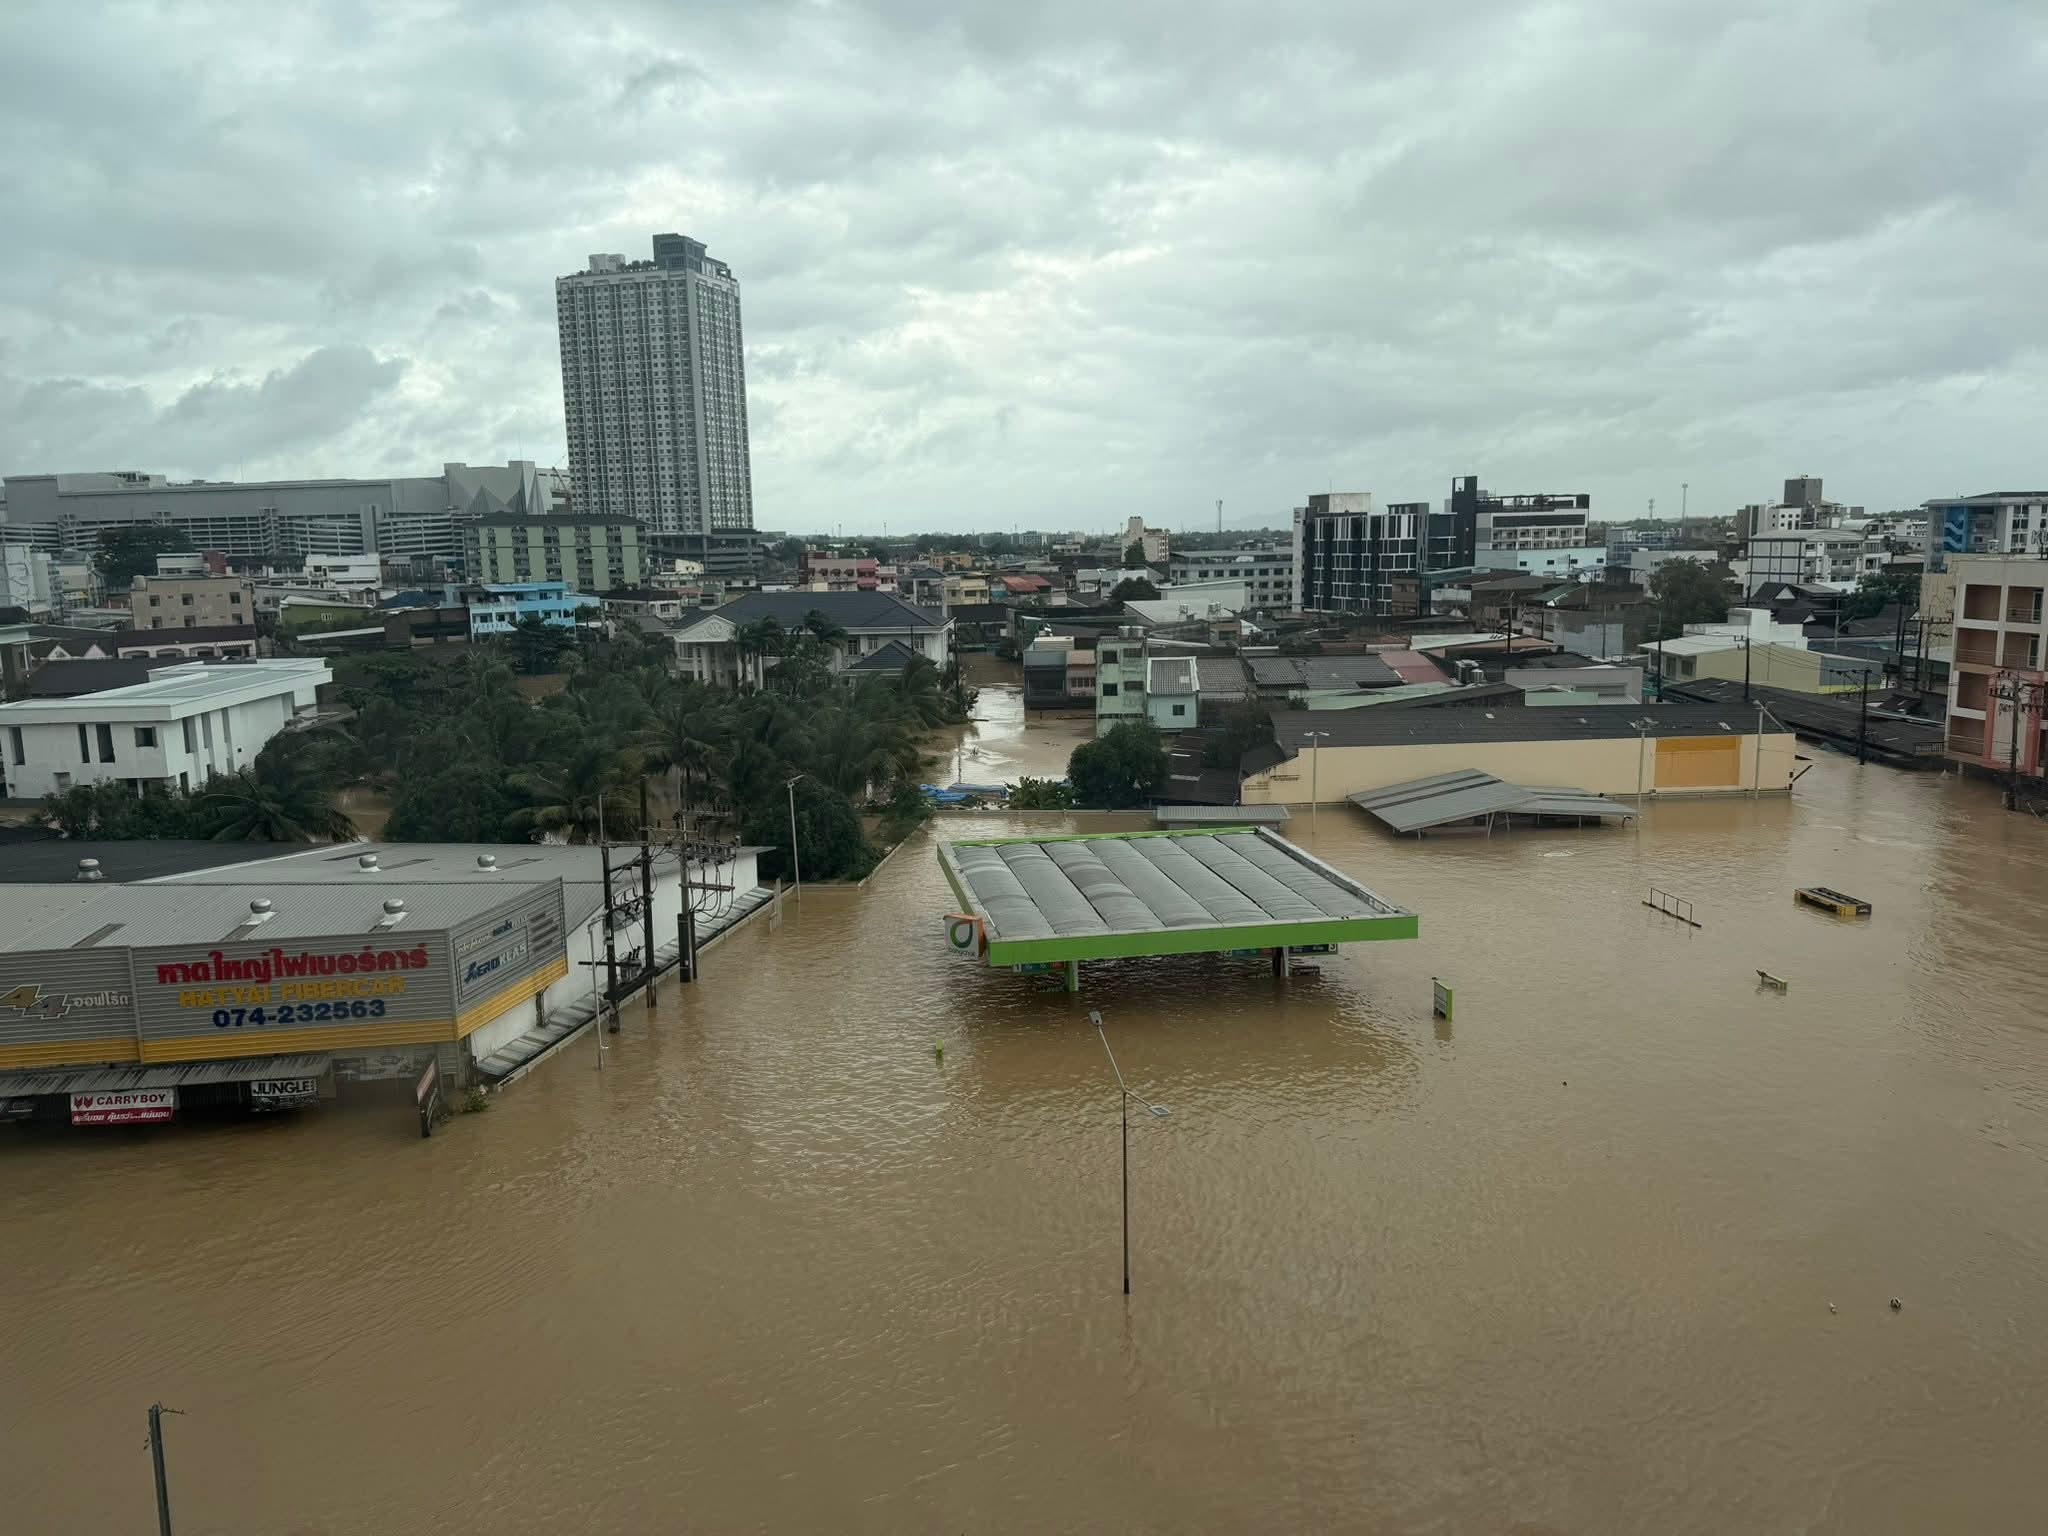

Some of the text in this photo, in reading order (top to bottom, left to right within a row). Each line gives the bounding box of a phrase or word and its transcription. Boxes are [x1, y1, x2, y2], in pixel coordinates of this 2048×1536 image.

[157, 943, 428, 984] หาดใหญ่ไฟเบอร์คาร์
[178, 985, 270, 1009] HATYAI
[212, 998, 386, 1028] 074-232563
[96, 1094, 166, 1106] CARRYBOY
[252, 1081, 310, 1095] JUNGLE
